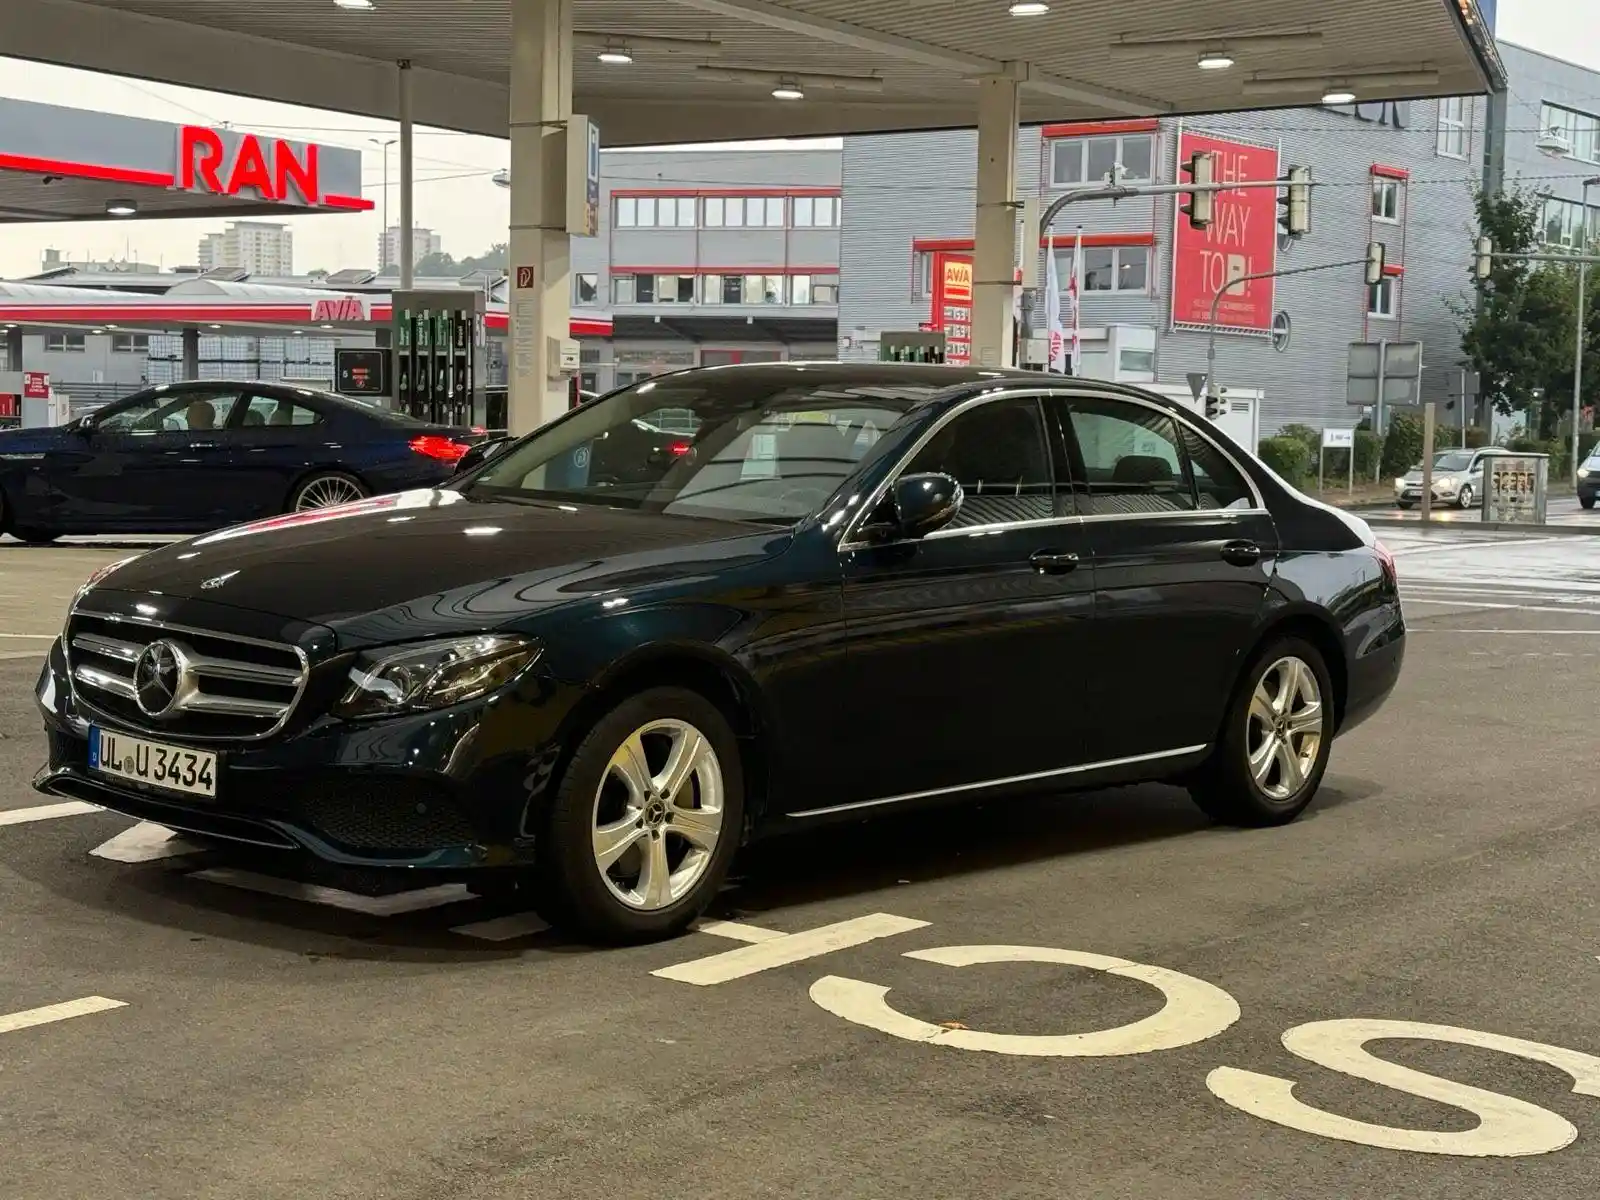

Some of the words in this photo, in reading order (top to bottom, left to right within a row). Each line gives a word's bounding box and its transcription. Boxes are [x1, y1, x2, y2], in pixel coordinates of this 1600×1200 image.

[180, 124, 319, 206] RAN
[1206, 202, 1251, 248] WAY
[946, 267, 970, 283] AVIA
[314, 295, 365, 321] AVIA
[100, 734, 122, 771] UL
[136, 743, 149, 778] U
[154, 747, 213, 791] 3434
